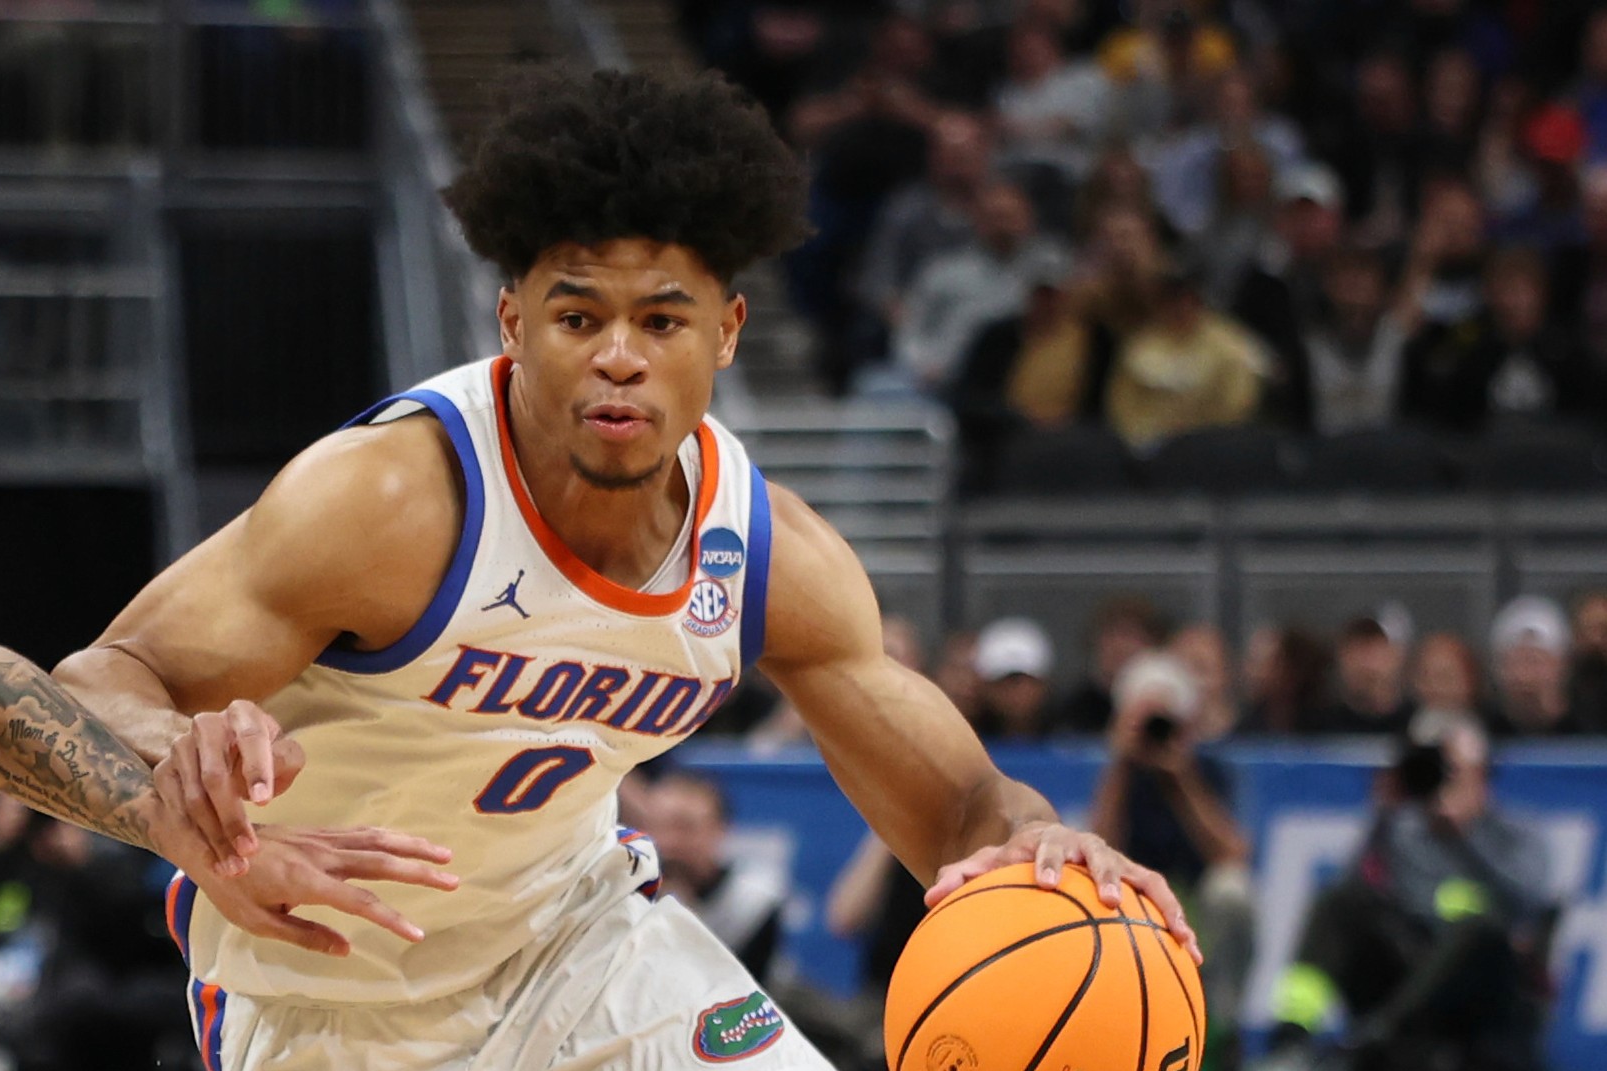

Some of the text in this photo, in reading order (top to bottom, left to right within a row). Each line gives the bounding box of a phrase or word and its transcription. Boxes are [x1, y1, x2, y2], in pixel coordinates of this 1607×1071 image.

[701, 550, 743, 567] NCAA
[689, 581, 728, 623] SEC
[56, 740, 91, 780] Dad
[472, 744, 597, 815] 0
